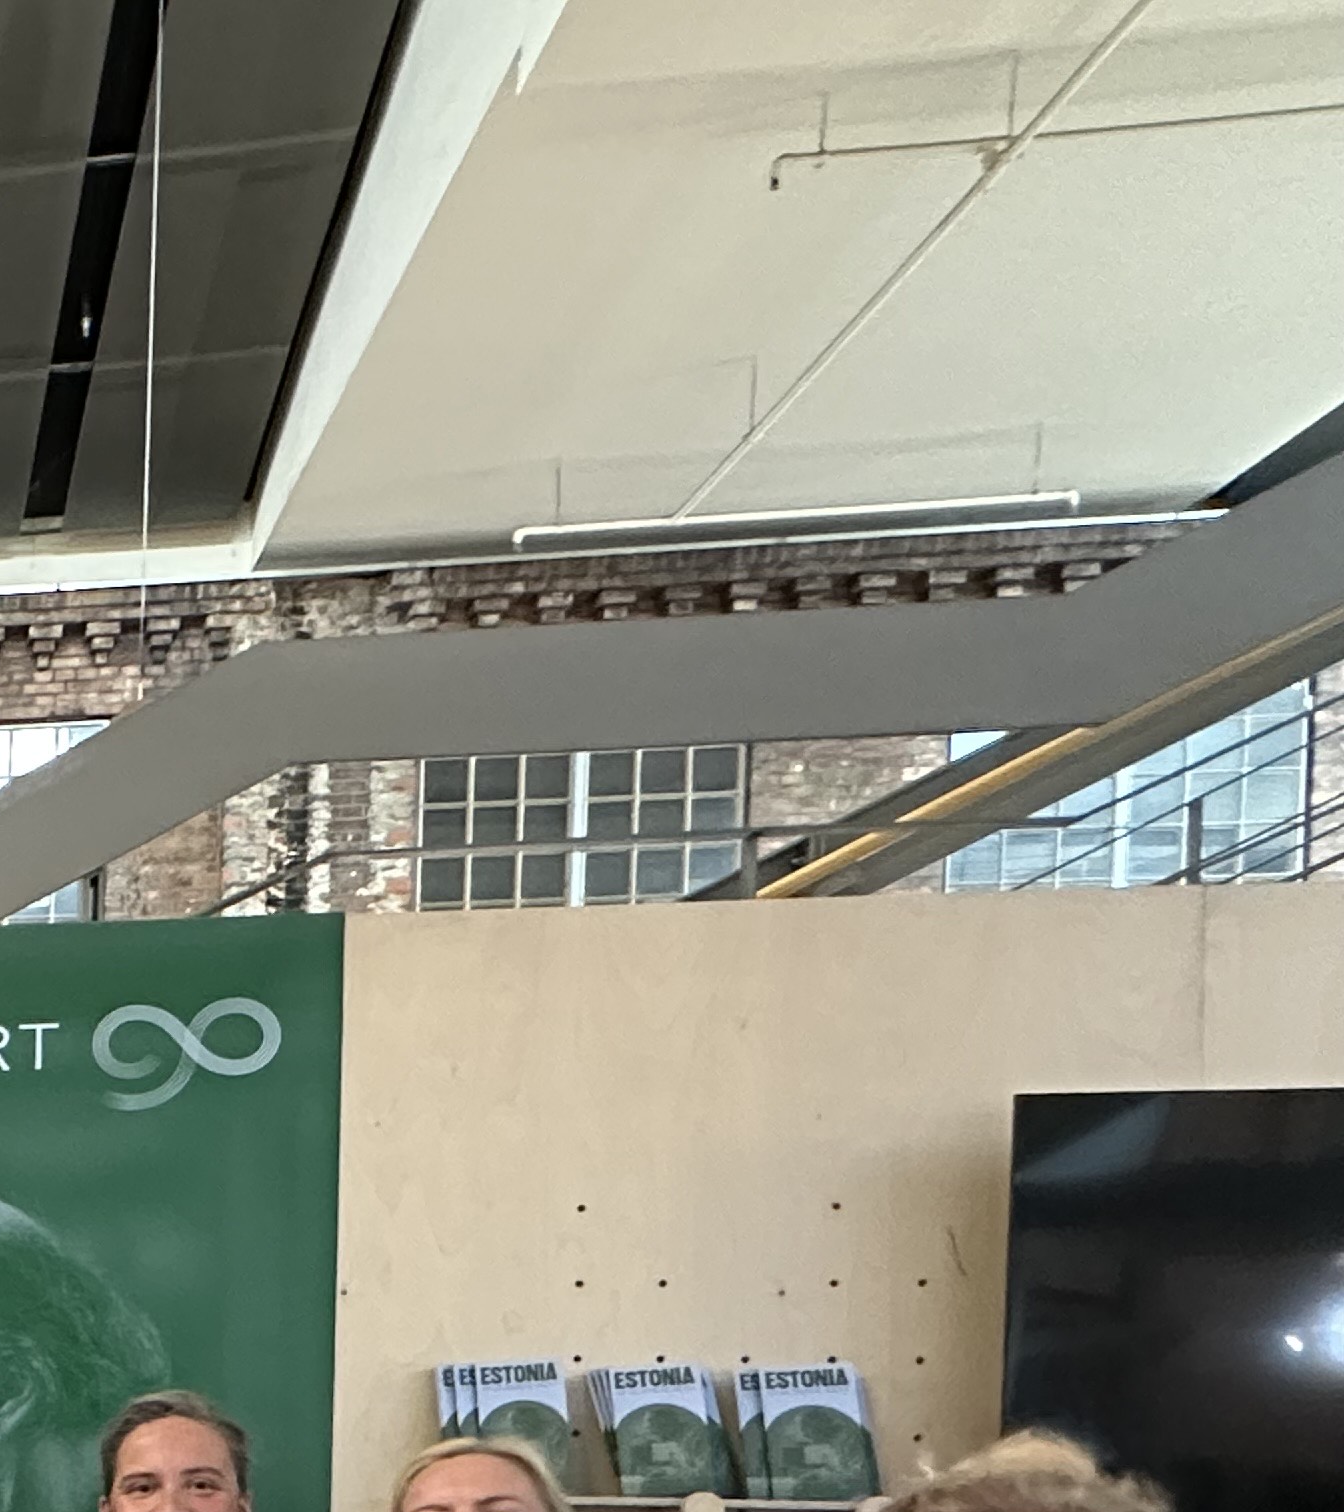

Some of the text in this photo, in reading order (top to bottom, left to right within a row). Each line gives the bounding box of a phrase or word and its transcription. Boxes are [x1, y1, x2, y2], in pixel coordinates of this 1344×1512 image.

[480, 1362, 558, 1385] ESTONIA
[614, 1366, 695, 1390] ESTONIA
[765, 1369, 849, 1390] ESTONIA
